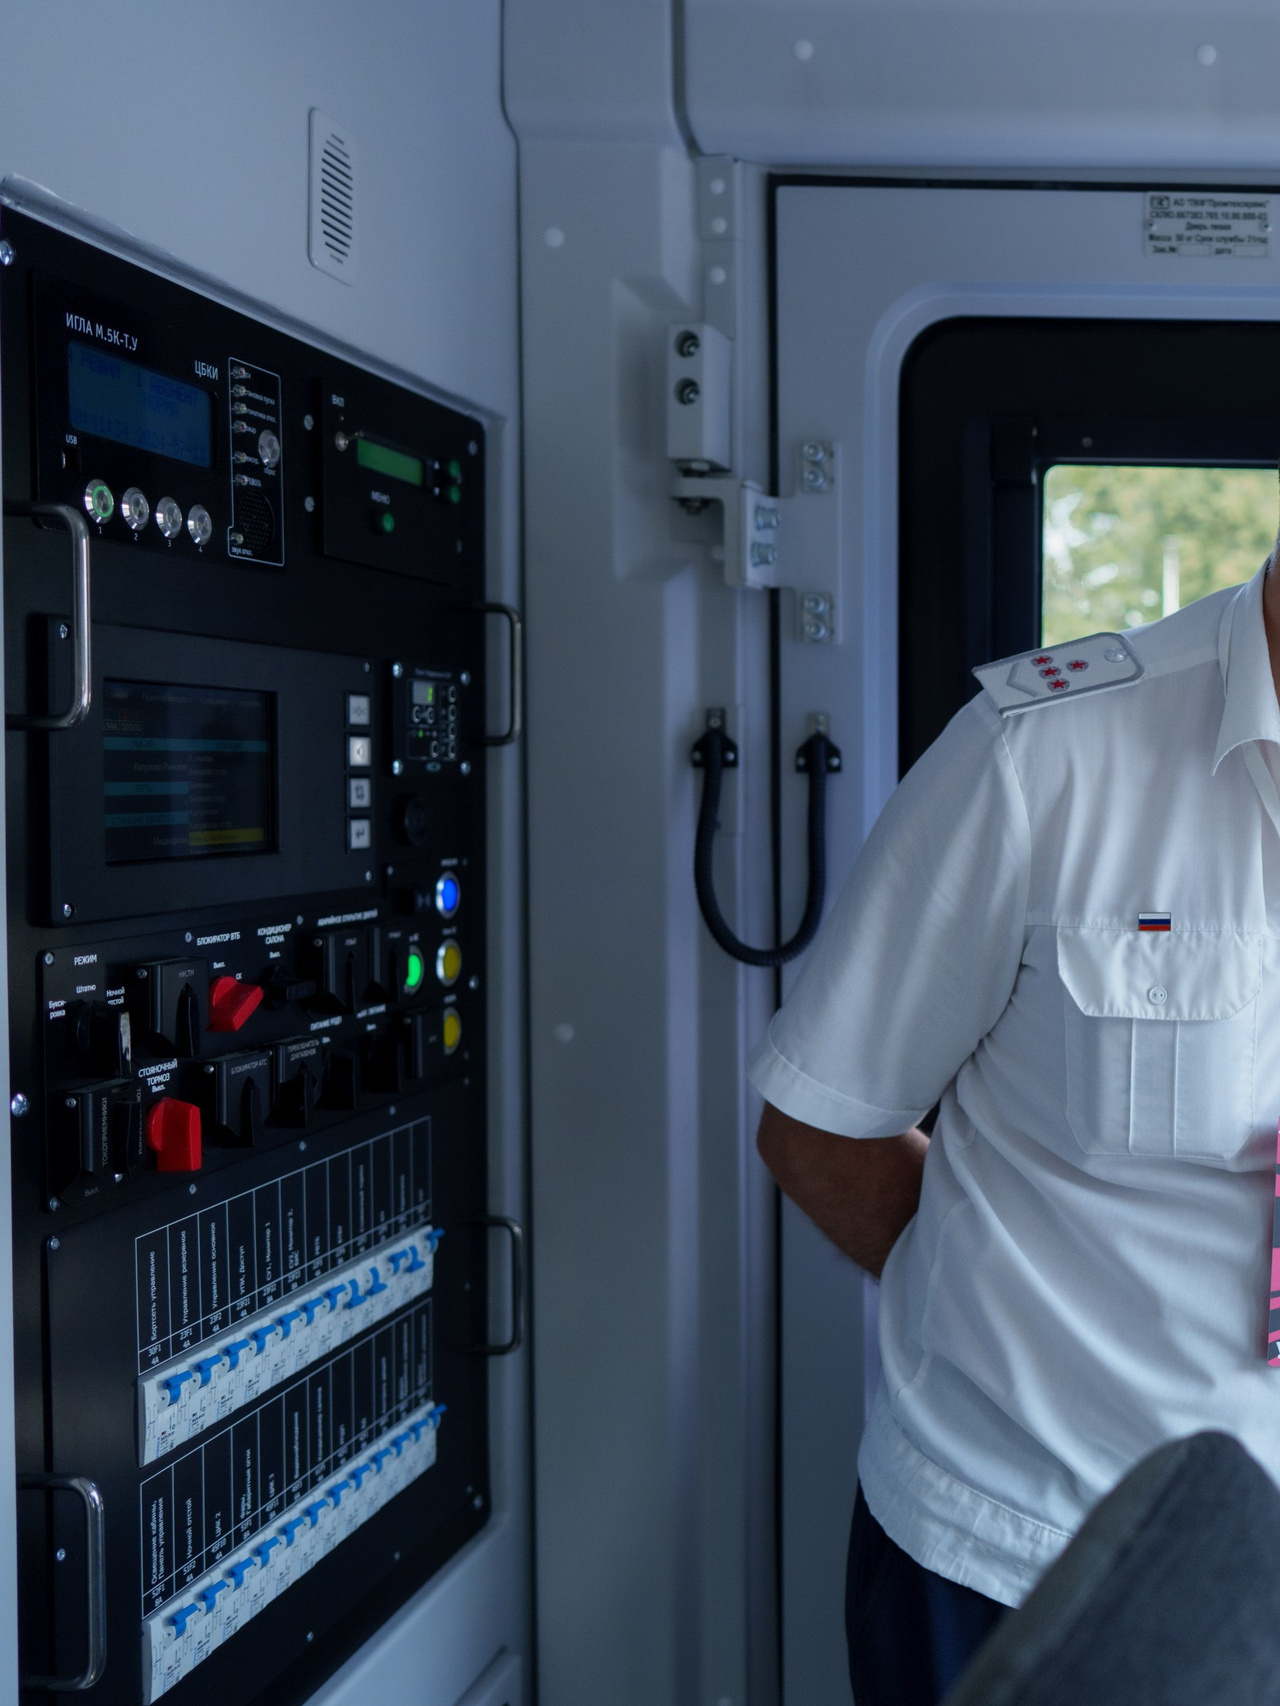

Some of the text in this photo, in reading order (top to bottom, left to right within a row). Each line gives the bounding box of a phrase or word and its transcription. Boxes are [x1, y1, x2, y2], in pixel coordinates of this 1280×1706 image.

[66, 312, 93, 336] ИГЛА
[195, 360, 219, 380] ЦБКИ
[66, 434, 78, 445] USB
[134, 533, 139, 542] 2
[168, 539, 172, 548] 3
[196, 933, 231, 947] БЛОКИРАТОР
[74, 954, 98, 966] РЕЖИМ
[76, 984, 97, 994] Штатно
[107, 986, 126, 997] Ночной
[50, 1009, 66, 1020] ровка
[138, 1058, 178, 1078] СТОЯНОЧНЫЙ
[147, 1073, 171, 1087] ТОРМОЗ
[150, 1251, 158, 1302] управление
